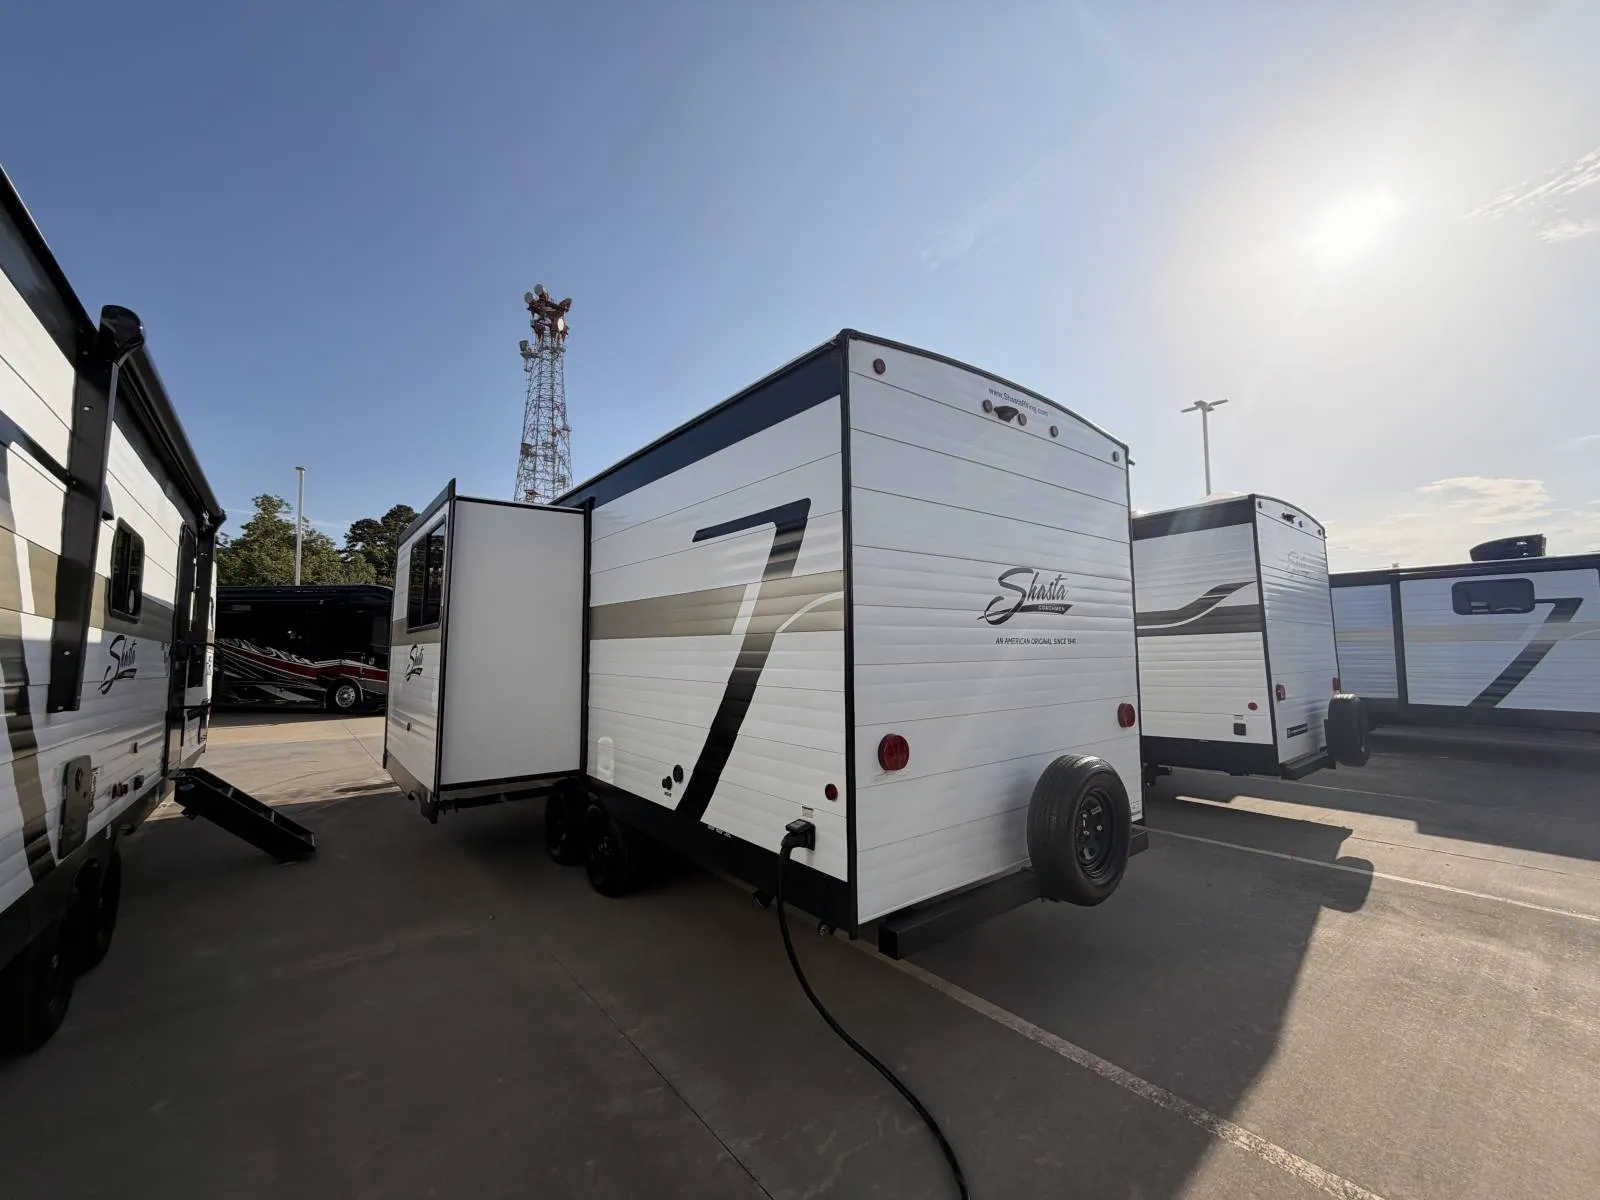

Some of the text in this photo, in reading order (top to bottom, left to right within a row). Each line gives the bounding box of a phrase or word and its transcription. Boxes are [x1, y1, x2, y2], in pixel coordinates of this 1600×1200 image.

[977, 567, 1069, 625] Shasta
[995, 637, 1004, 645] AN
[1004, 637, 1030, 645] AMERICAN
[1031, 637, 1052, 645] ORIGINAL
[1053, 637, 1066, 645] SINCE
